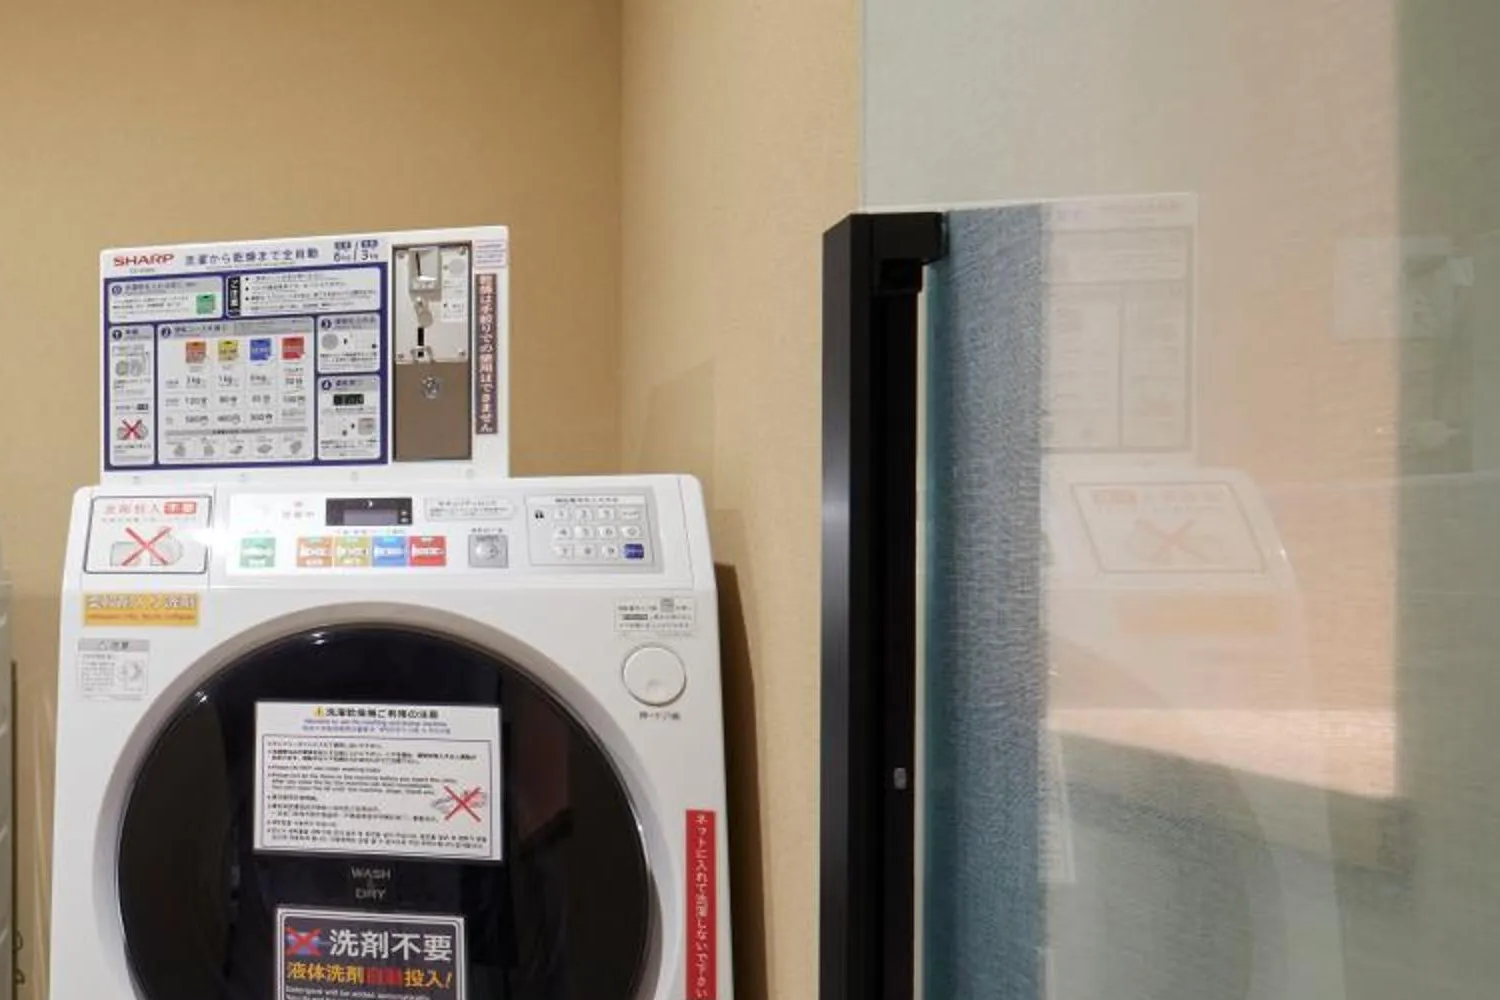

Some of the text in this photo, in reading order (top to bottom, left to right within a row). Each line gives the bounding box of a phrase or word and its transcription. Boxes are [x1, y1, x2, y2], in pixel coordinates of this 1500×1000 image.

[113, 253, 174, 267] SHARP
[351, 868, 391, 879] WASH
[356, 888, 385, 899] DRY
[329, 928, 453, 961] 洗剤不要
